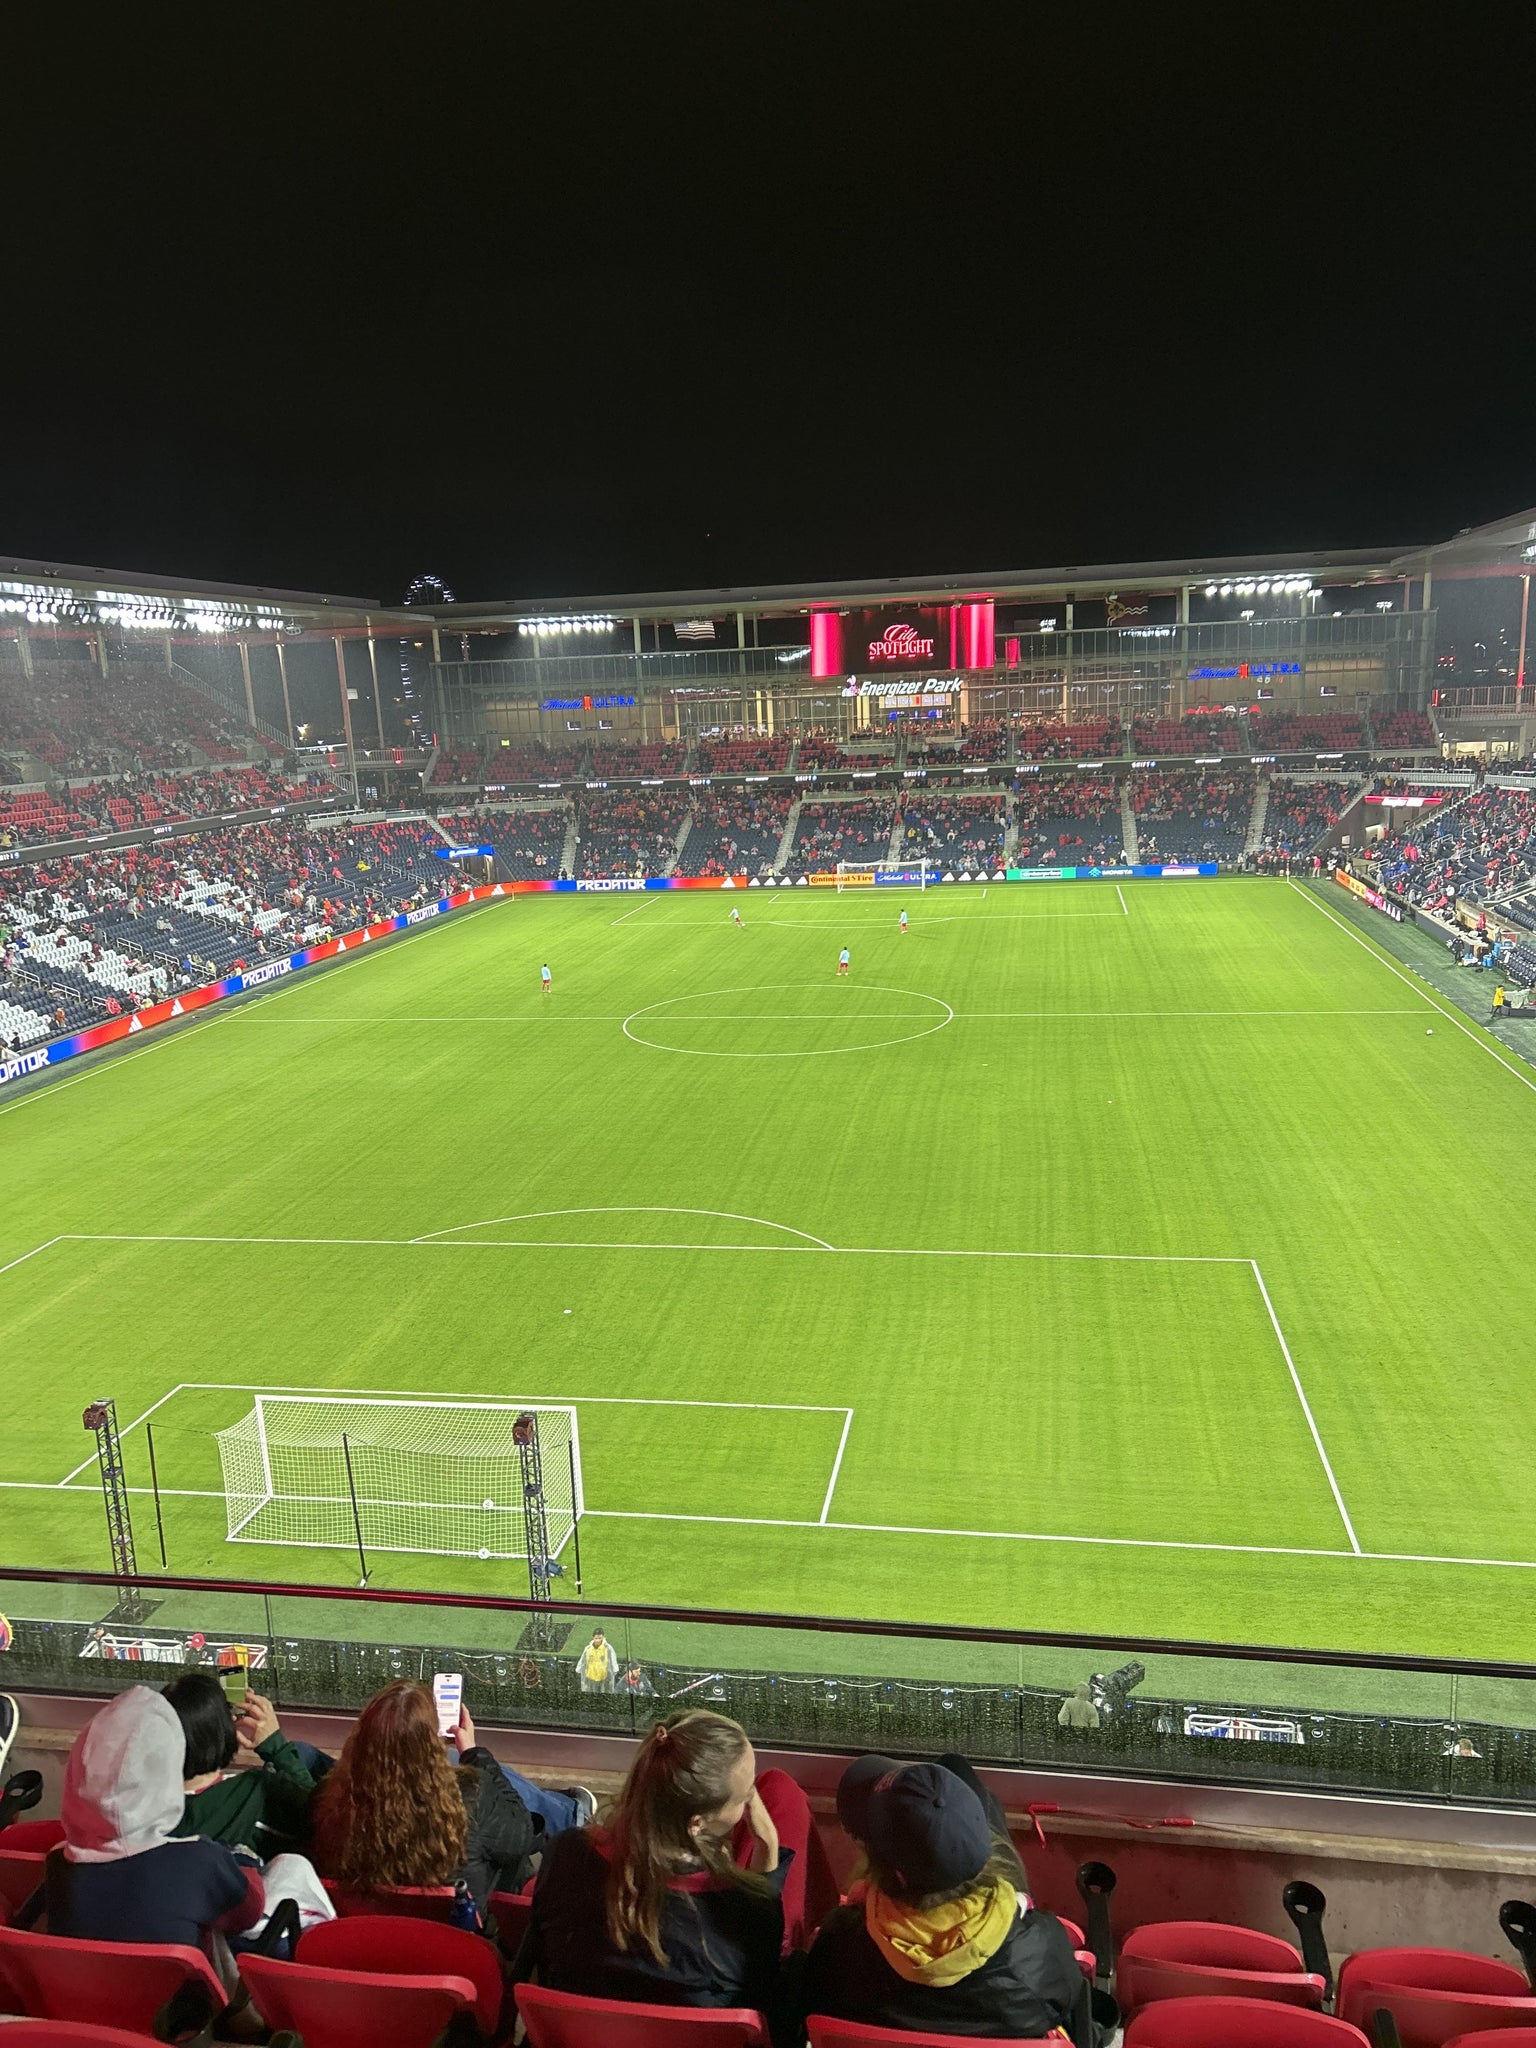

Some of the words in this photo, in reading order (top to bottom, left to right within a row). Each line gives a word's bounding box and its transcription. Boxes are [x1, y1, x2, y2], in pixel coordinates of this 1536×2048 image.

[884, 624, 918, 645] City
[869, 639, 934, 656] SPOTLIGHT
[1251, 662, 1301, 676] ULTRA
[860, 680, 922, 697] Energizer
[923, 677, 964, 694] Park
[593, 695, 636, 709] ULTRA
[576, 879, 646, 891] PREDATOR
[406, 903, 439, 926] PREDATOR
[241, 957, 293, 989] PREDATOR
